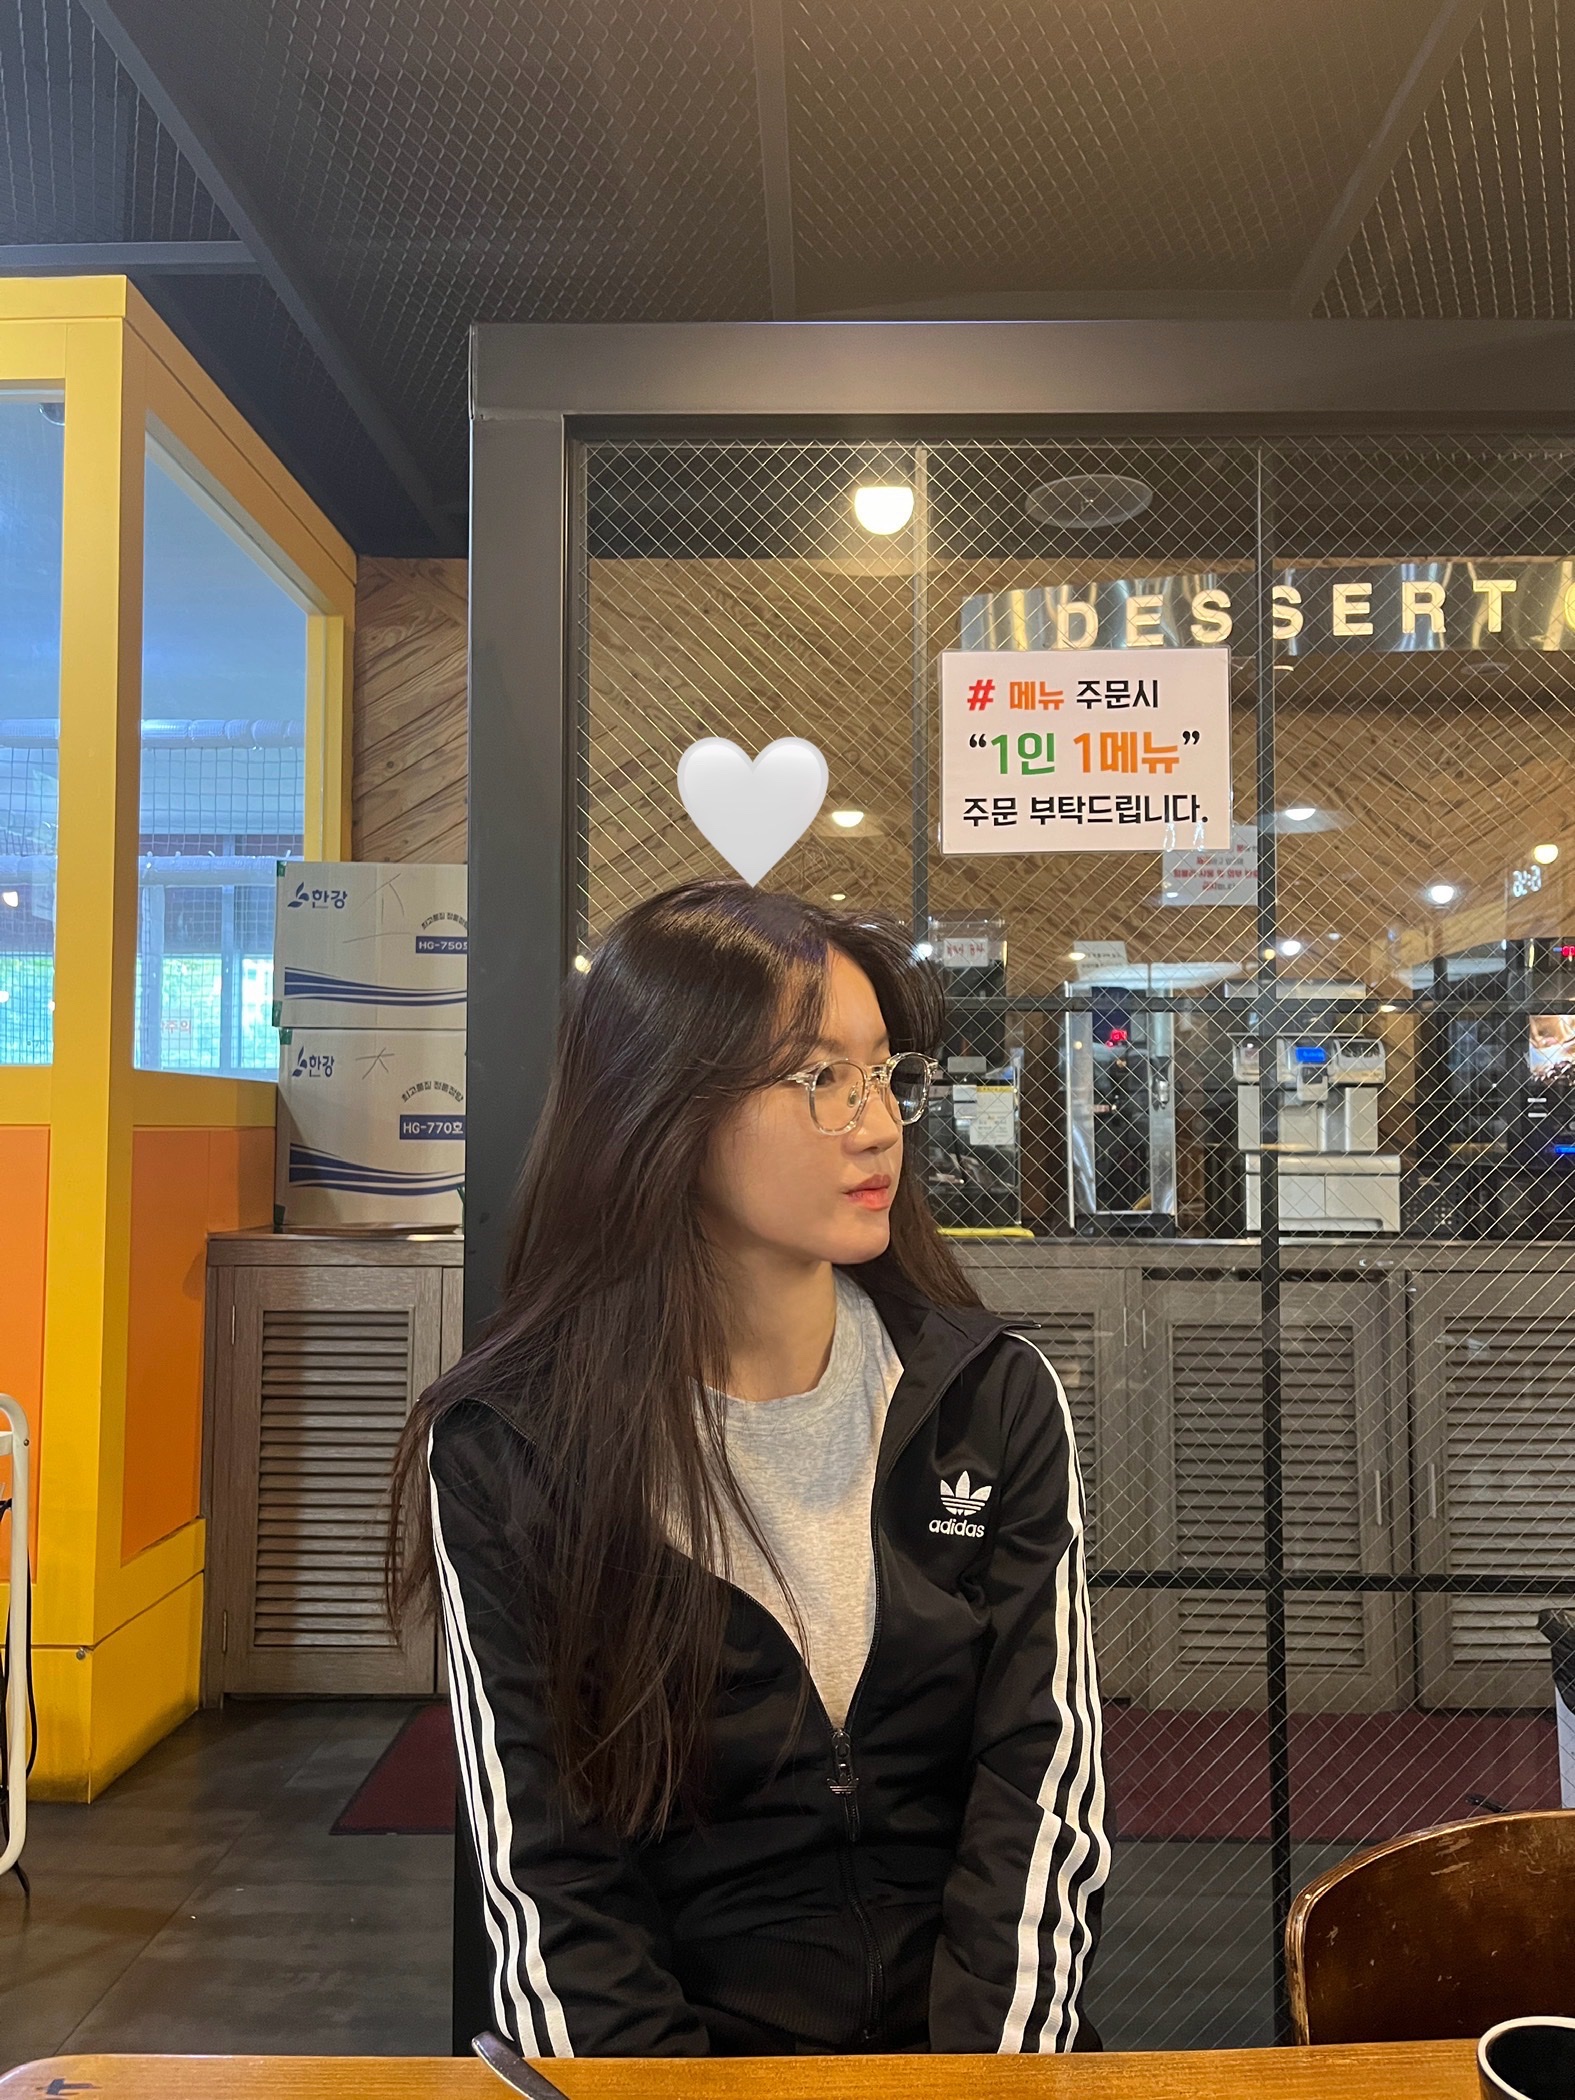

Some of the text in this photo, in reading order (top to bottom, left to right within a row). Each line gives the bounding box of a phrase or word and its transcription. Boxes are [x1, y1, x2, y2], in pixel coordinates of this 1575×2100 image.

[1056, 578, 1517, 650] DESSERT
[966, 679, 1160, 712] # 메뉴 주문시
[962, 793, 1209, 827] 주문 부탁드립니다.
[311, 888, 348, 910] 한강
[308, 1053, 335, 1078] 한강
[402, 1121, 465, 1135] HG-770호
[928, 1518, 986, 1538] adidas
